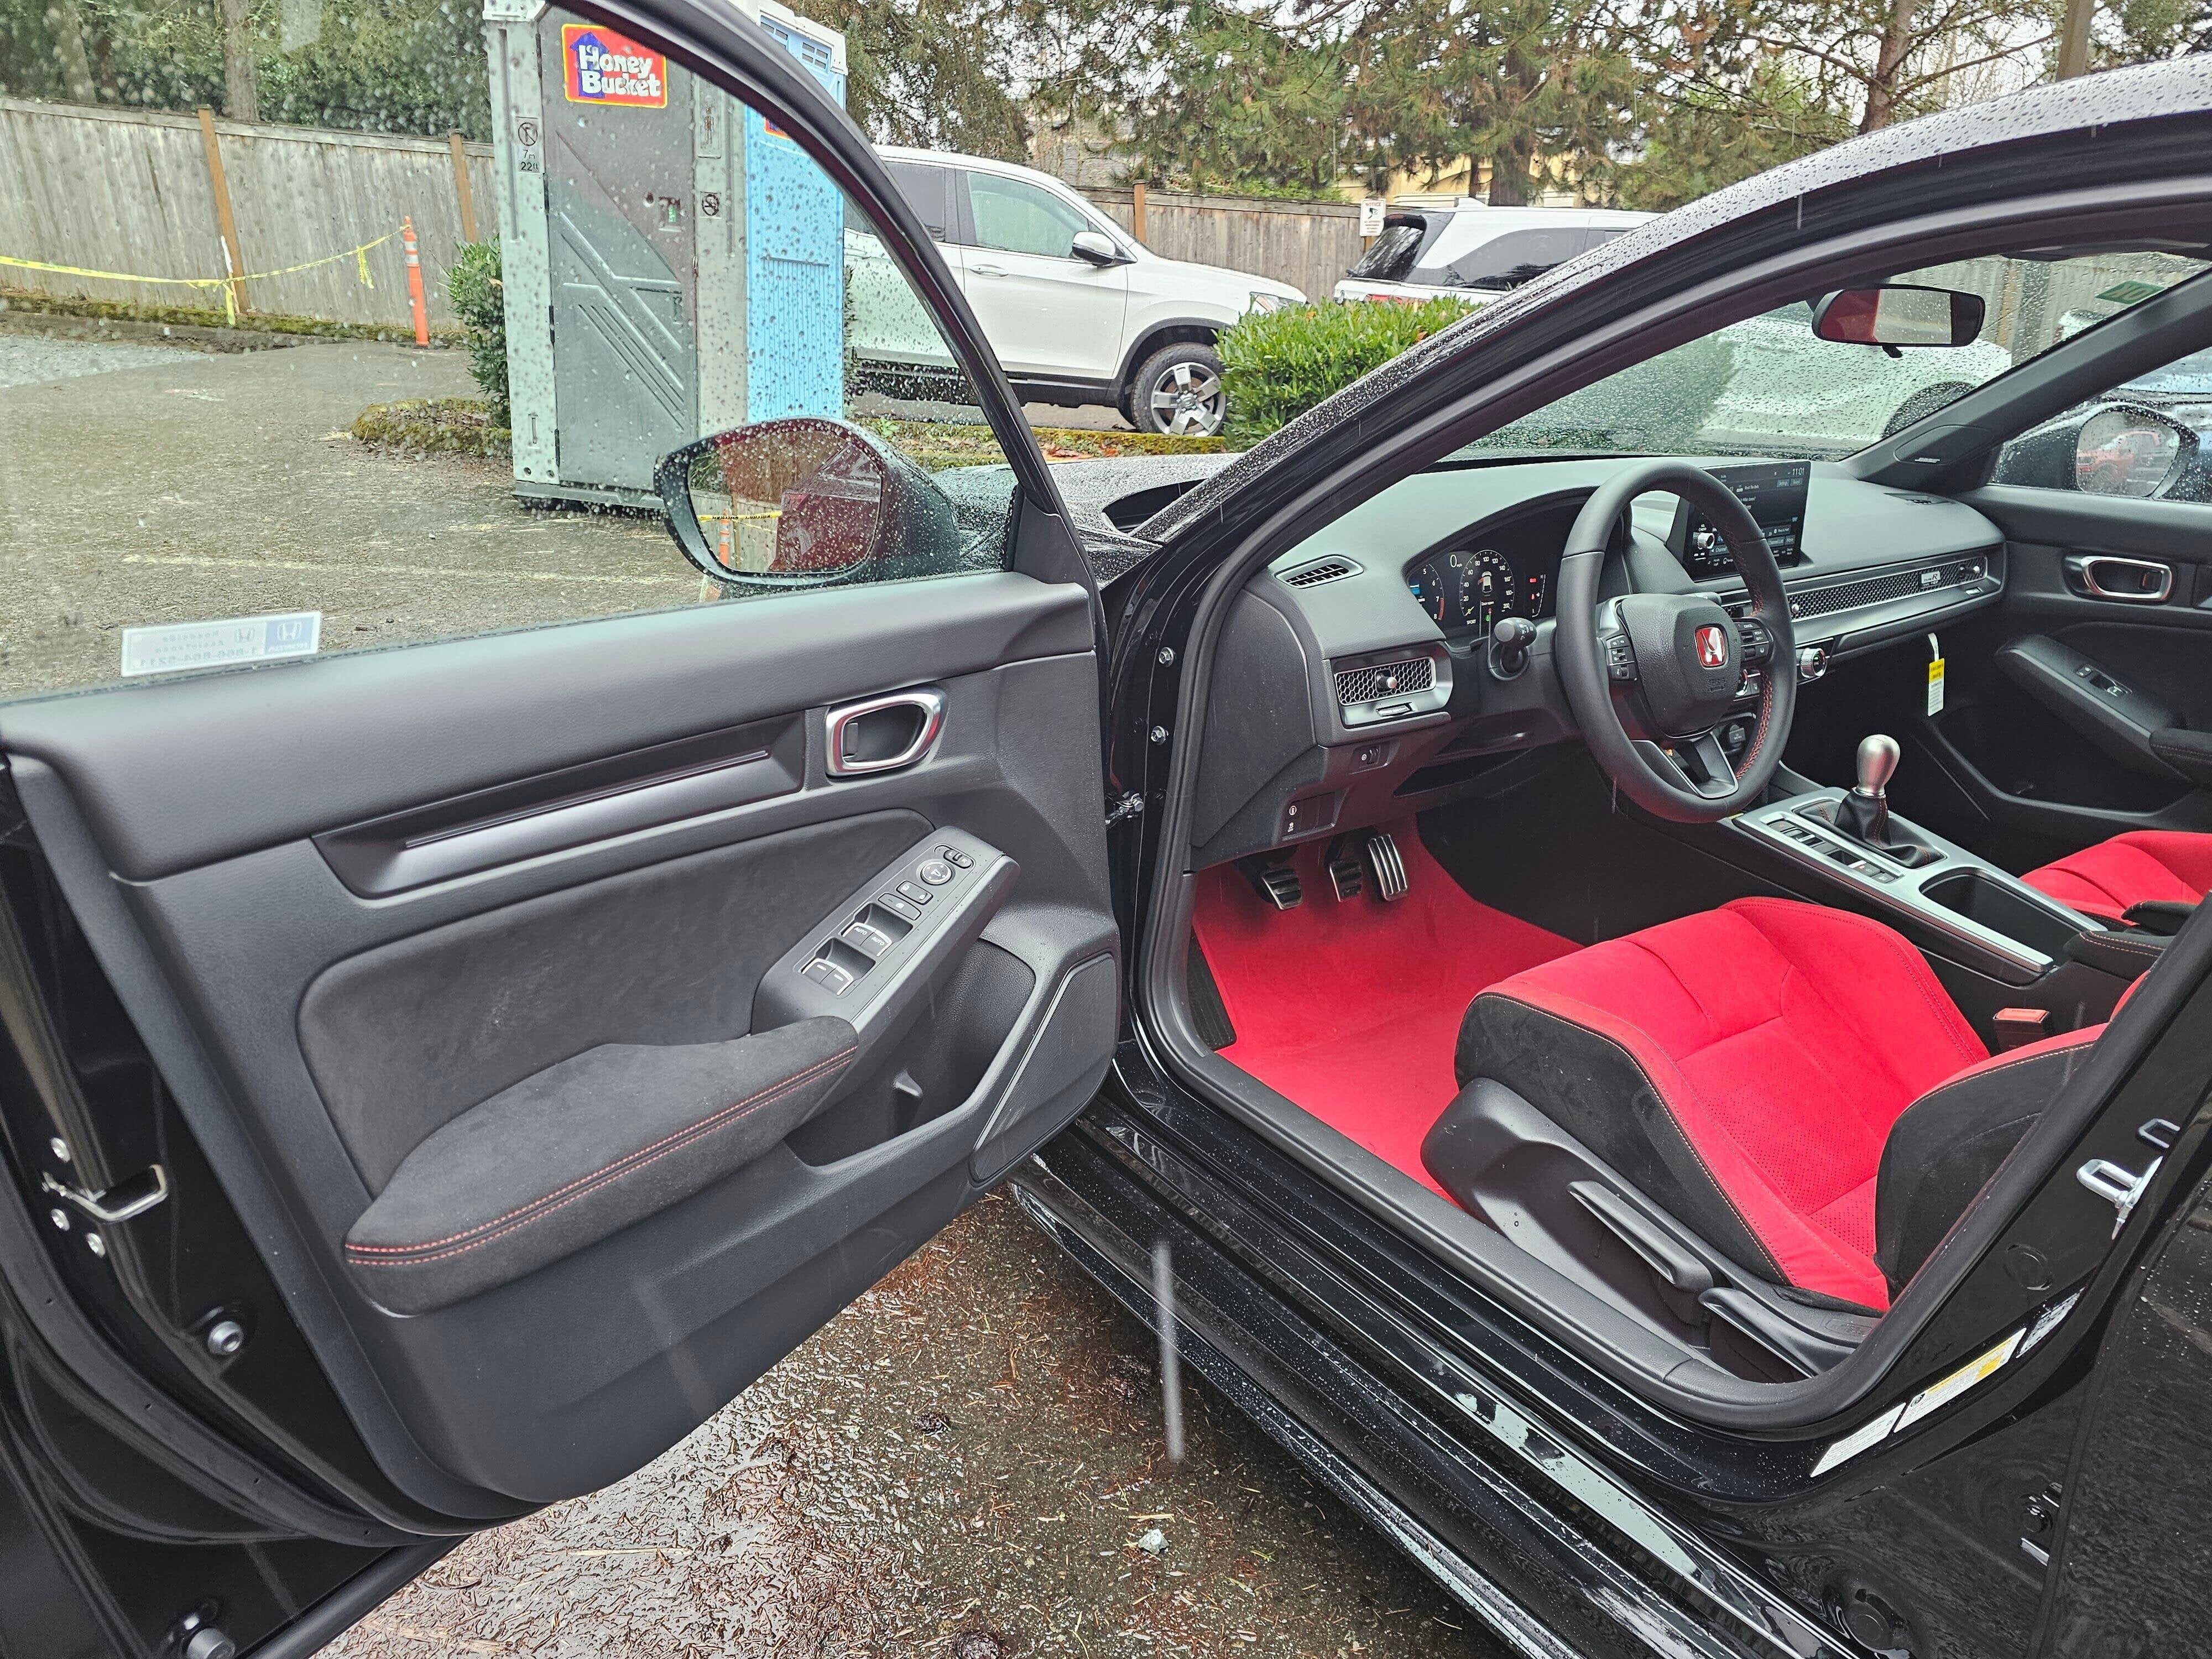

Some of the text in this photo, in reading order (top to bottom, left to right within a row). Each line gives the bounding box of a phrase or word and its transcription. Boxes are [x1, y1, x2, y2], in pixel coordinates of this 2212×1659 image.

[578, 45, 653, 79] Honey
[581, 70, 661, 97] Bucket
[854, 927, 868, 935] AUTO
[872, 936, 885, 946] AUTO
